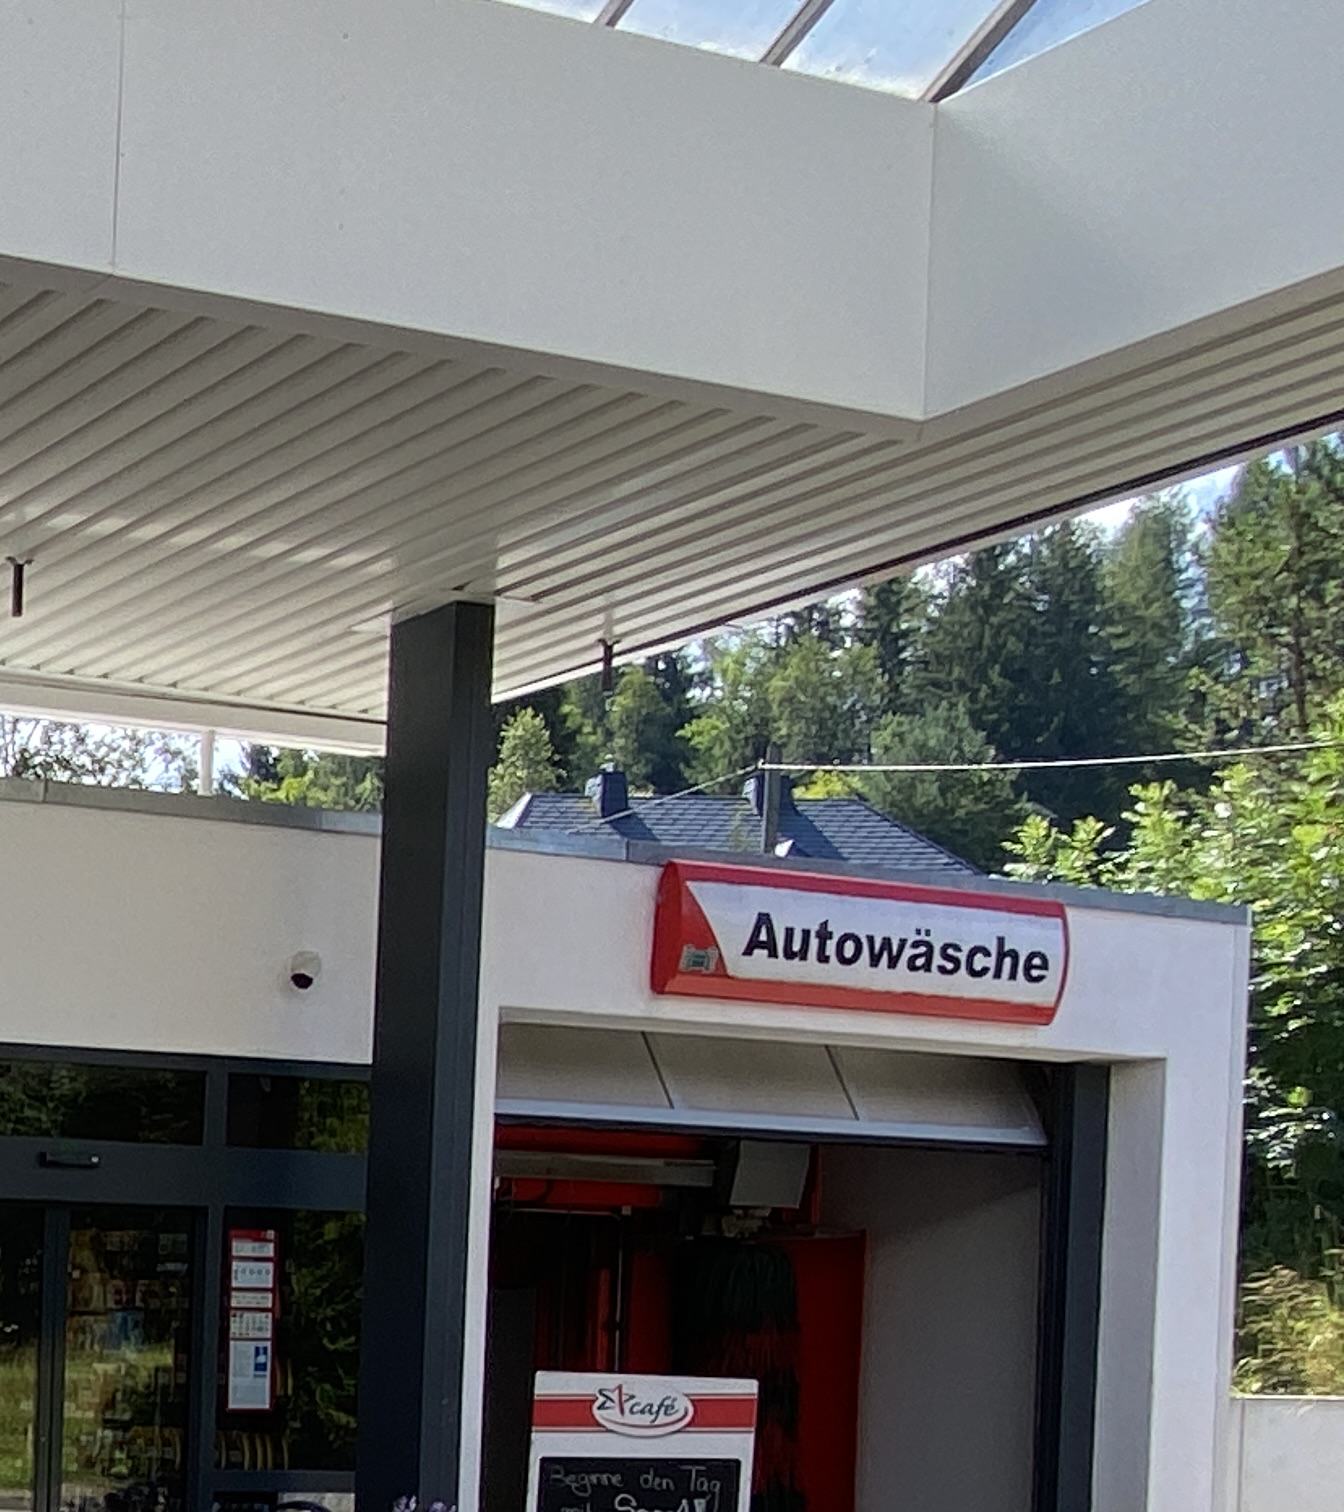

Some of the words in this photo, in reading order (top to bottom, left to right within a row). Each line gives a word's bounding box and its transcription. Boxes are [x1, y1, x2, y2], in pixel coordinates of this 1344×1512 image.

[741, 911, 1049, 983] Autowäsche
[629, 1394, 681, 1424] café
[639, 1467, 675, 1491] den
